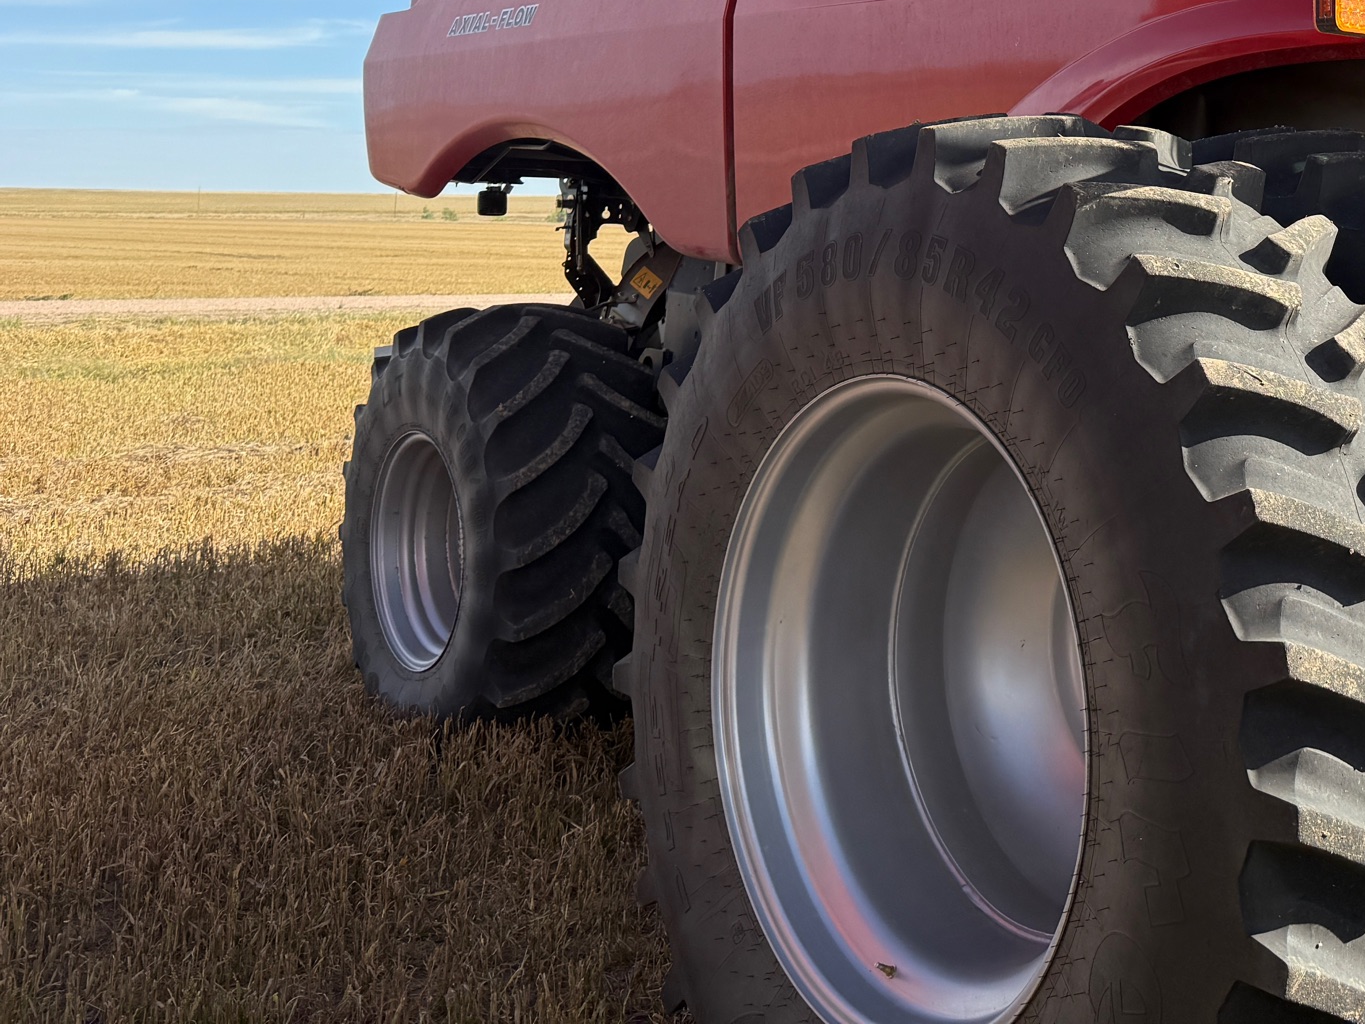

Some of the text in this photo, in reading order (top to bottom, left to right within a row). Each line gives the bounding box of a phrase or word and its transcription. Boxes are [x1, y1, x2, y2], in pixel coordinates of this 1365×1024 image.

[447, 3, 539, 37] AXIAL-FLOW
[753, 270, 788, 334] VF
[796, 227, 1031, 343] 580/85R42
